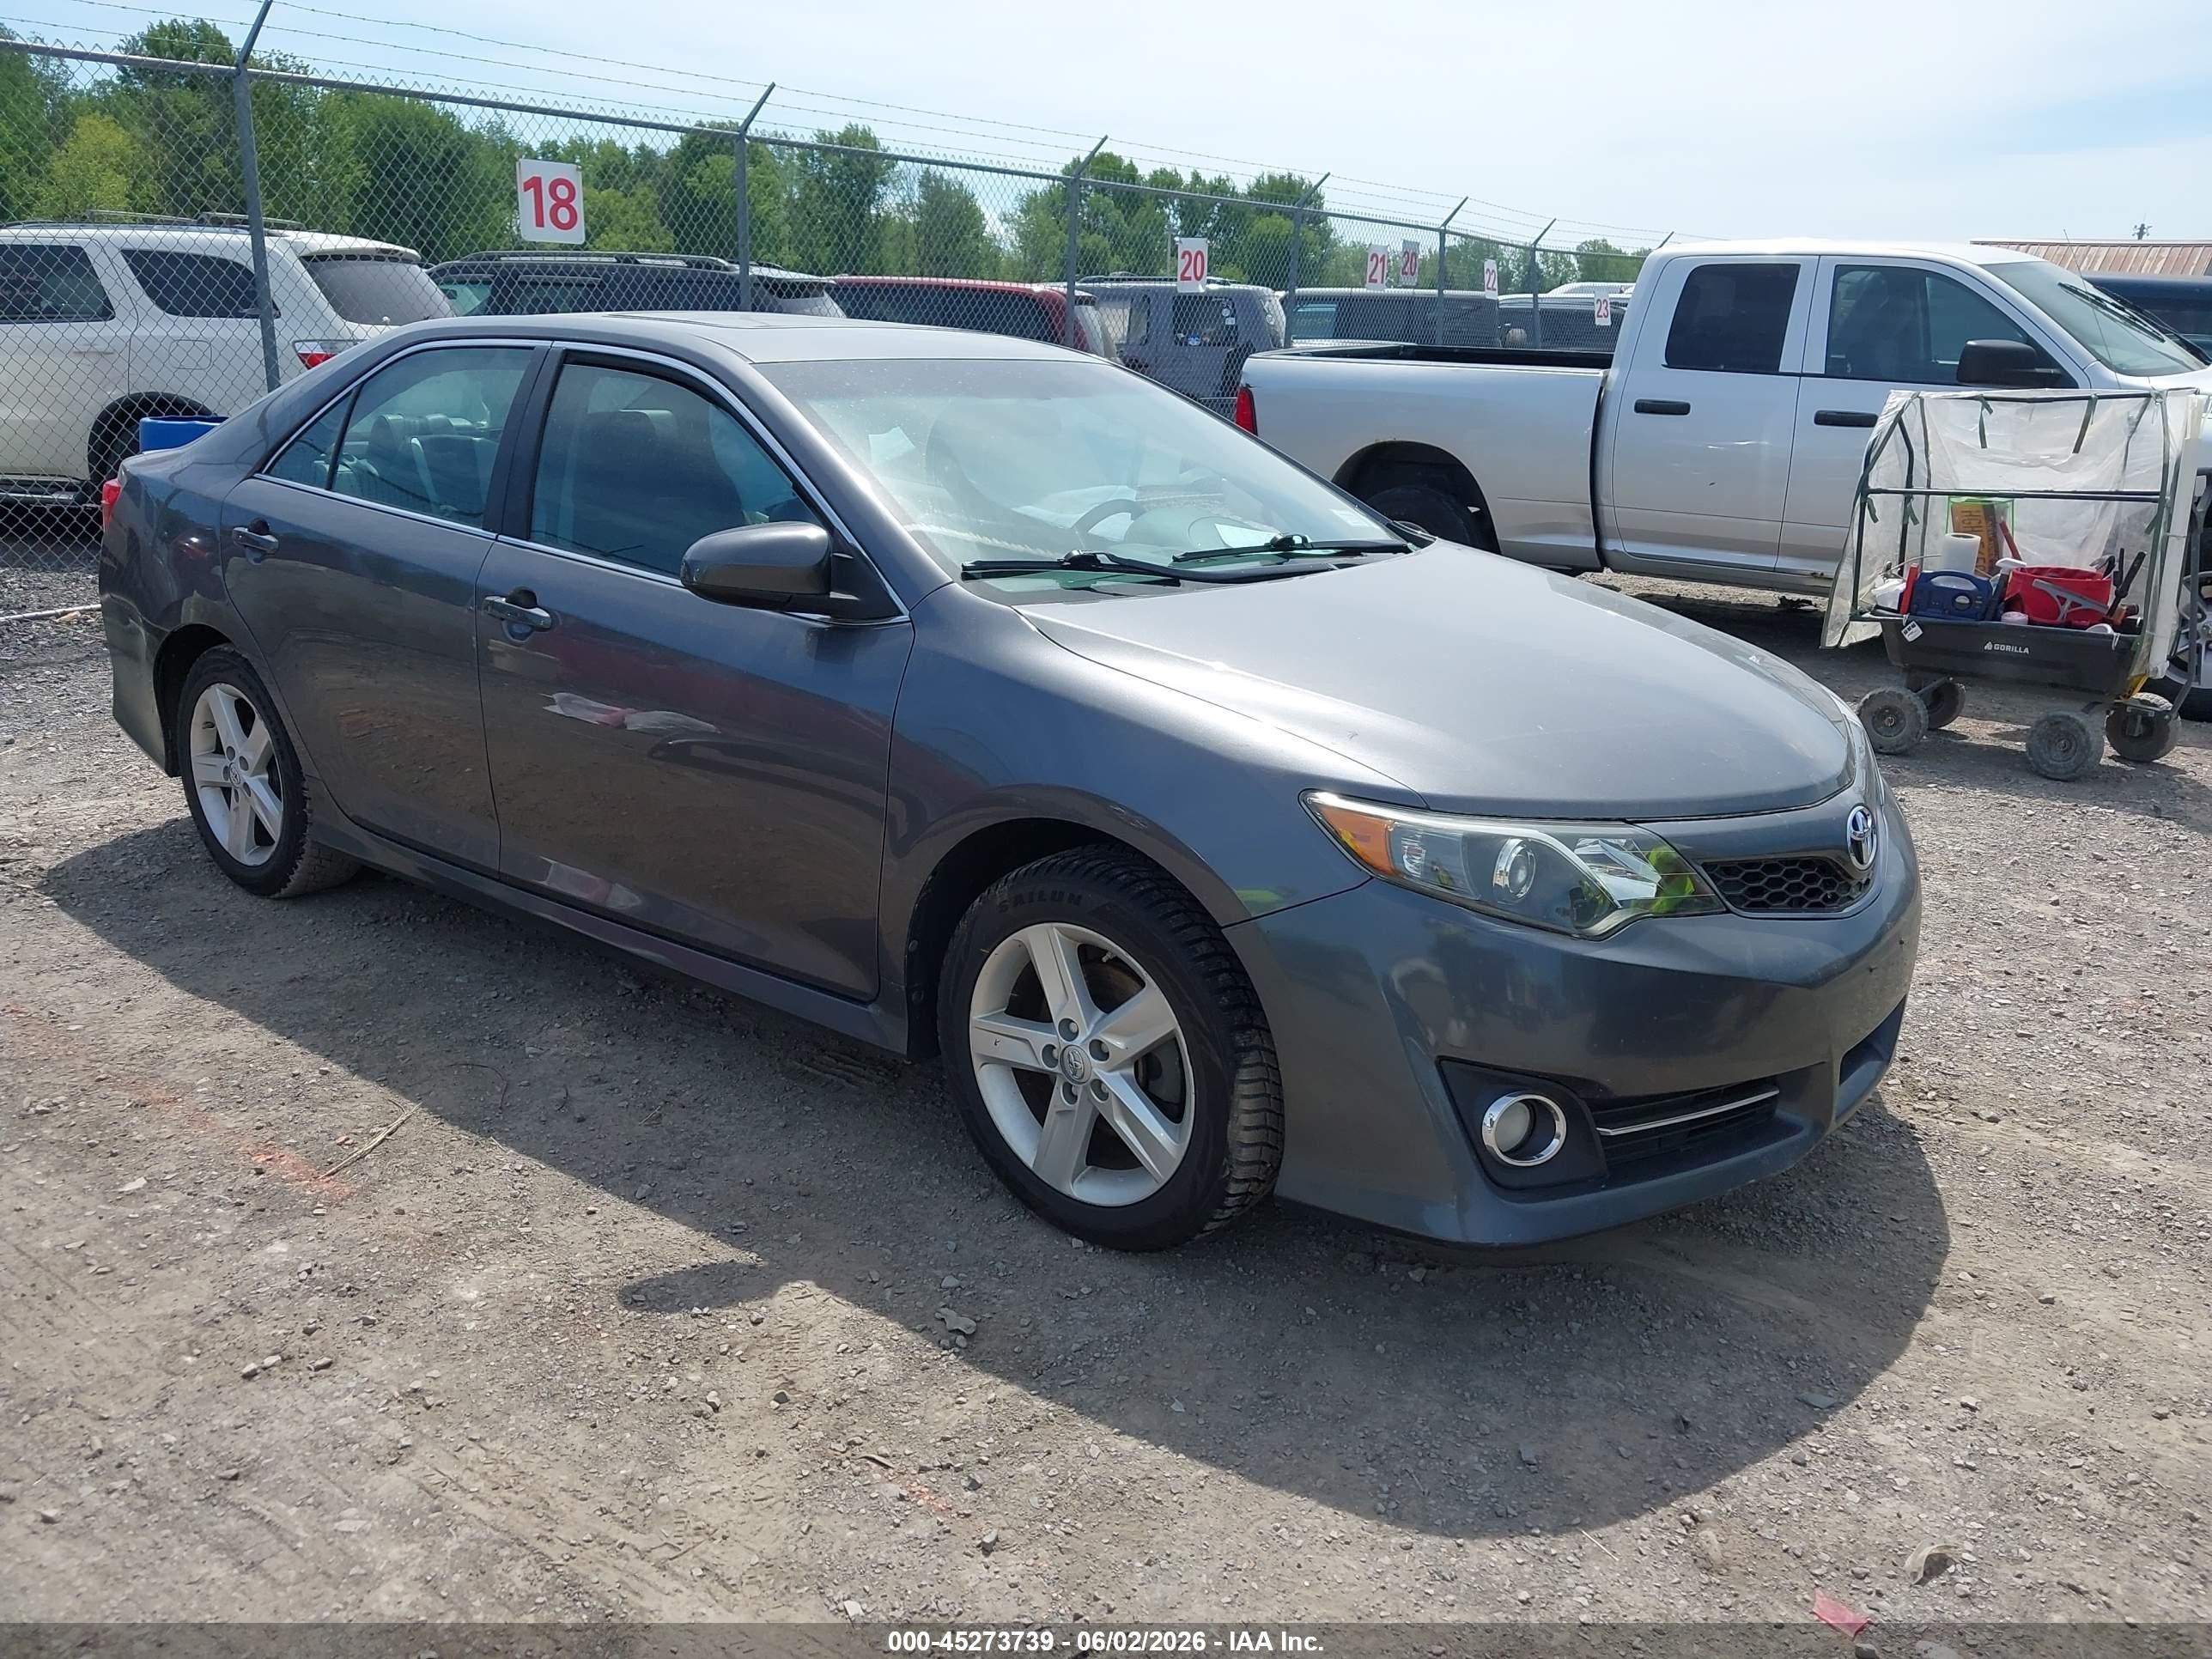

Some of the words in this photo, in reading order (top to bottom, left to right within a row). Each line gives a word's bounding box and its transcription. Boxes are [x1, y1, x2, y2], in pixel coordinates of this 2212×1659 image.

[522, 175, 578, 231] 18
[1179, 250, 1205, 282] 20
[1368, 252, 1386, 284] 21
[1401, 250, 1417, 276] 20
[1485, 269, 1497, 291] 22
[1595, 298, 1608, 318] 23
[1993, 643, 2030, 654] GORILLA
[998, 890, 1083, 914] SAILUN
